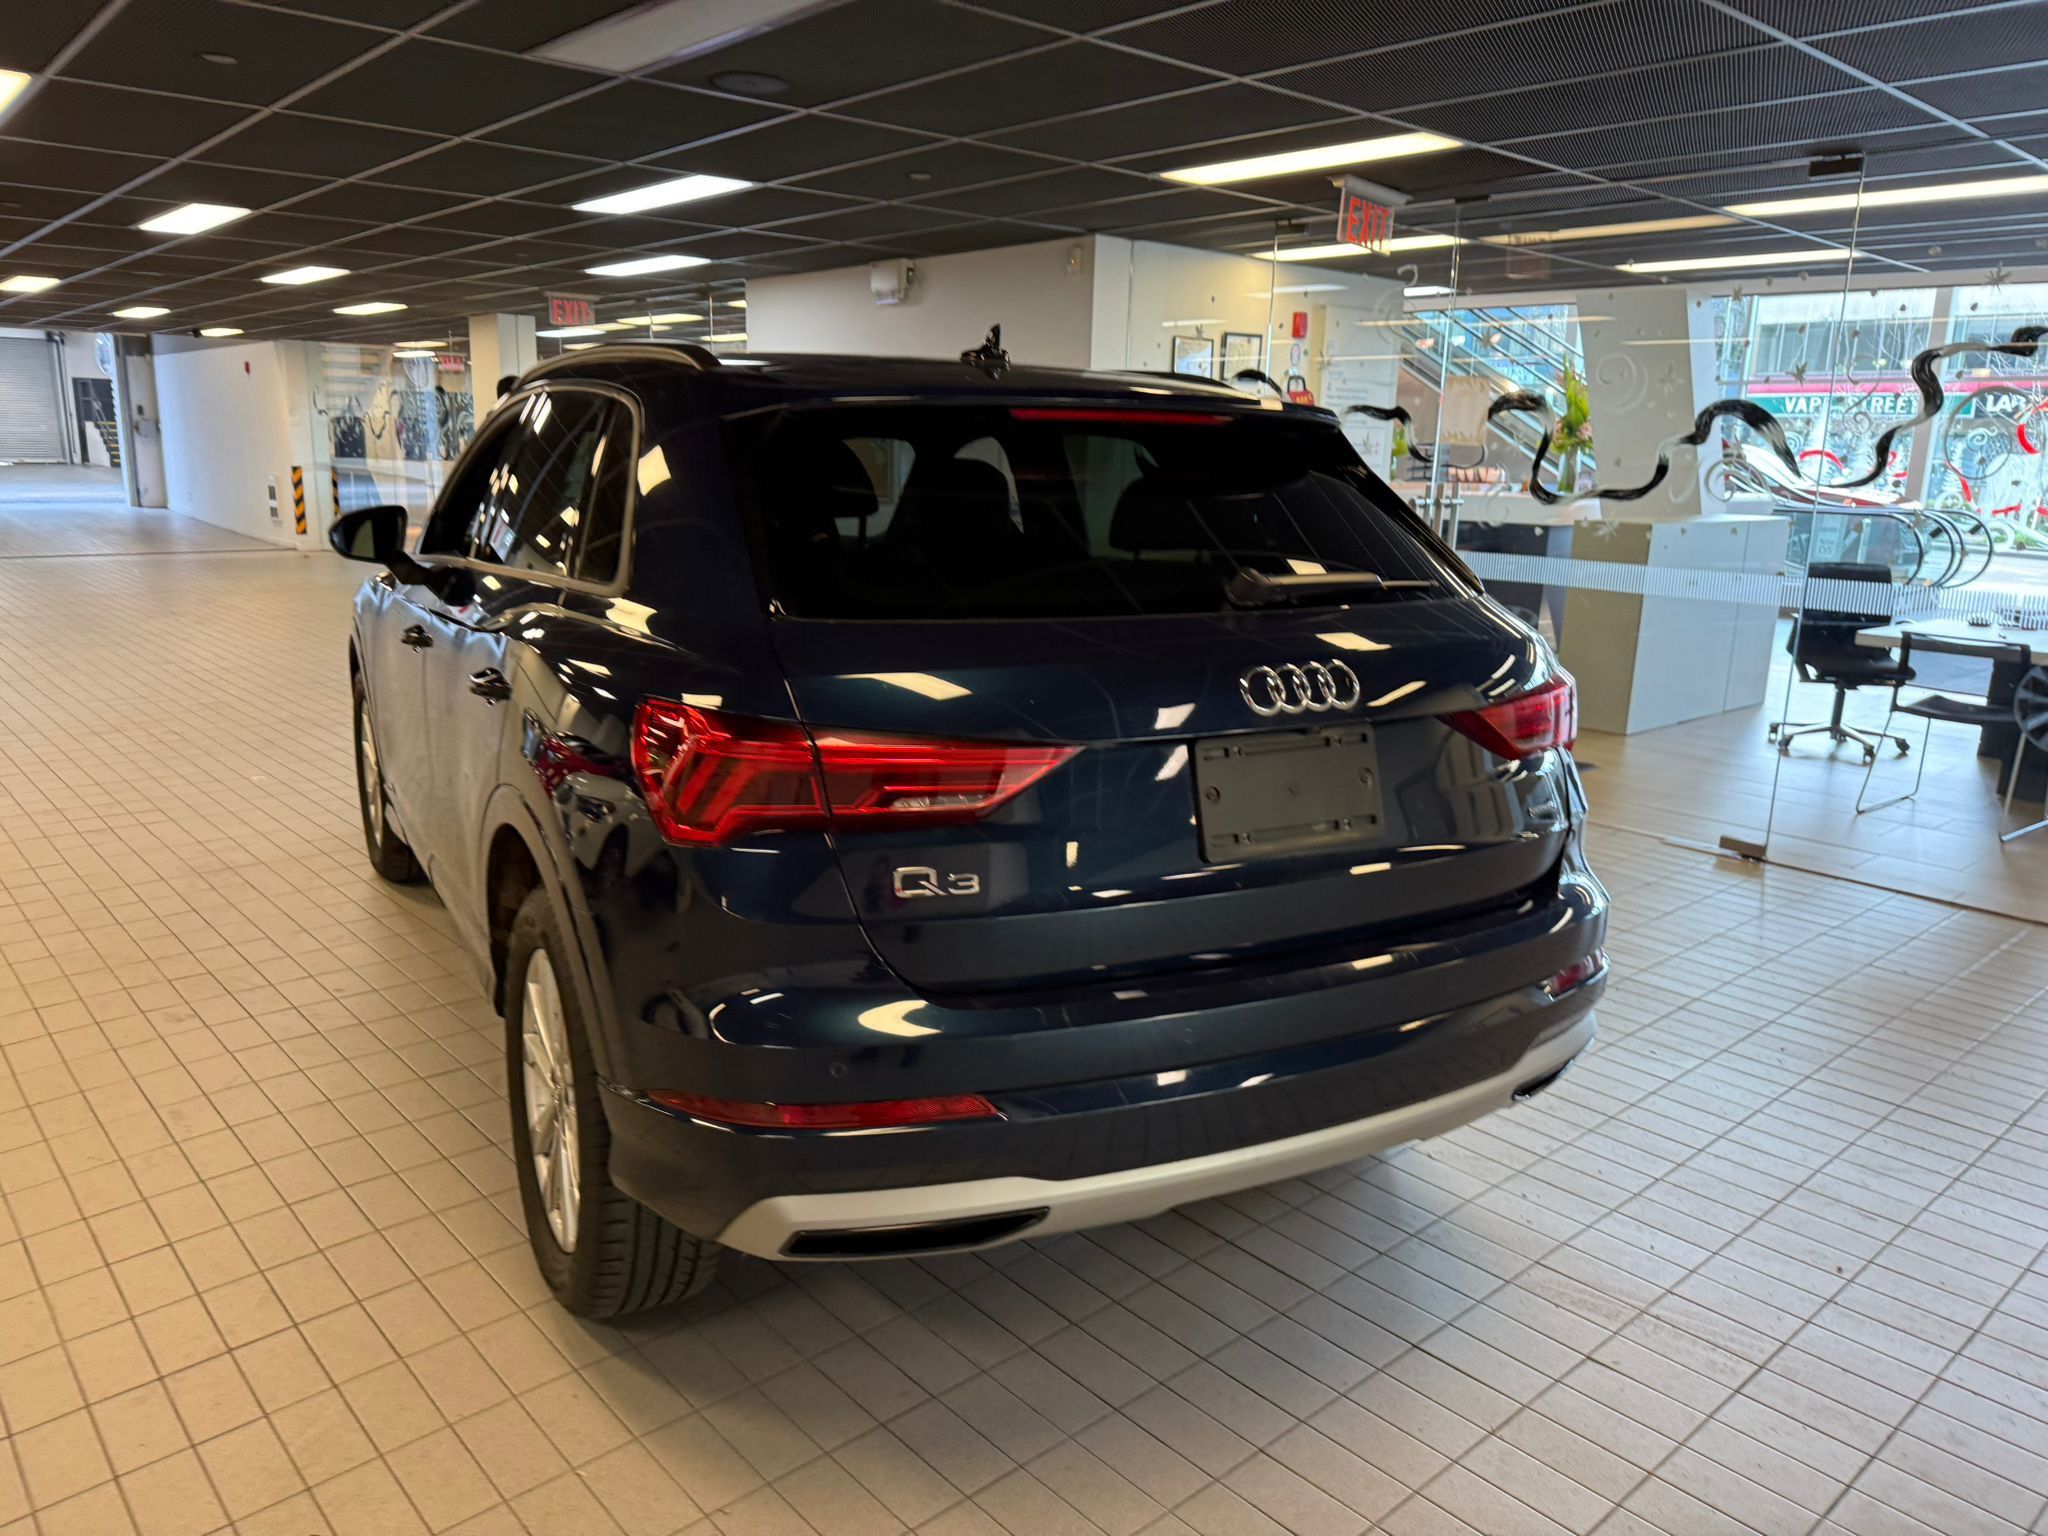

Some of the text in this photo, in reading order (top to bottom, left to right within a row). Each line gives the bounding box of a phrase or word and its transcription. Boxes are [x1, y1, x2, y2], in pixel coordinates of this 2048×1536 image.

[1347, 196, 1391, 252] EXIT
[552, 299, 592, 326] EXIT
[1784, 396, 1833, 414] VAP
[893, 866, 981, 898] Q3
